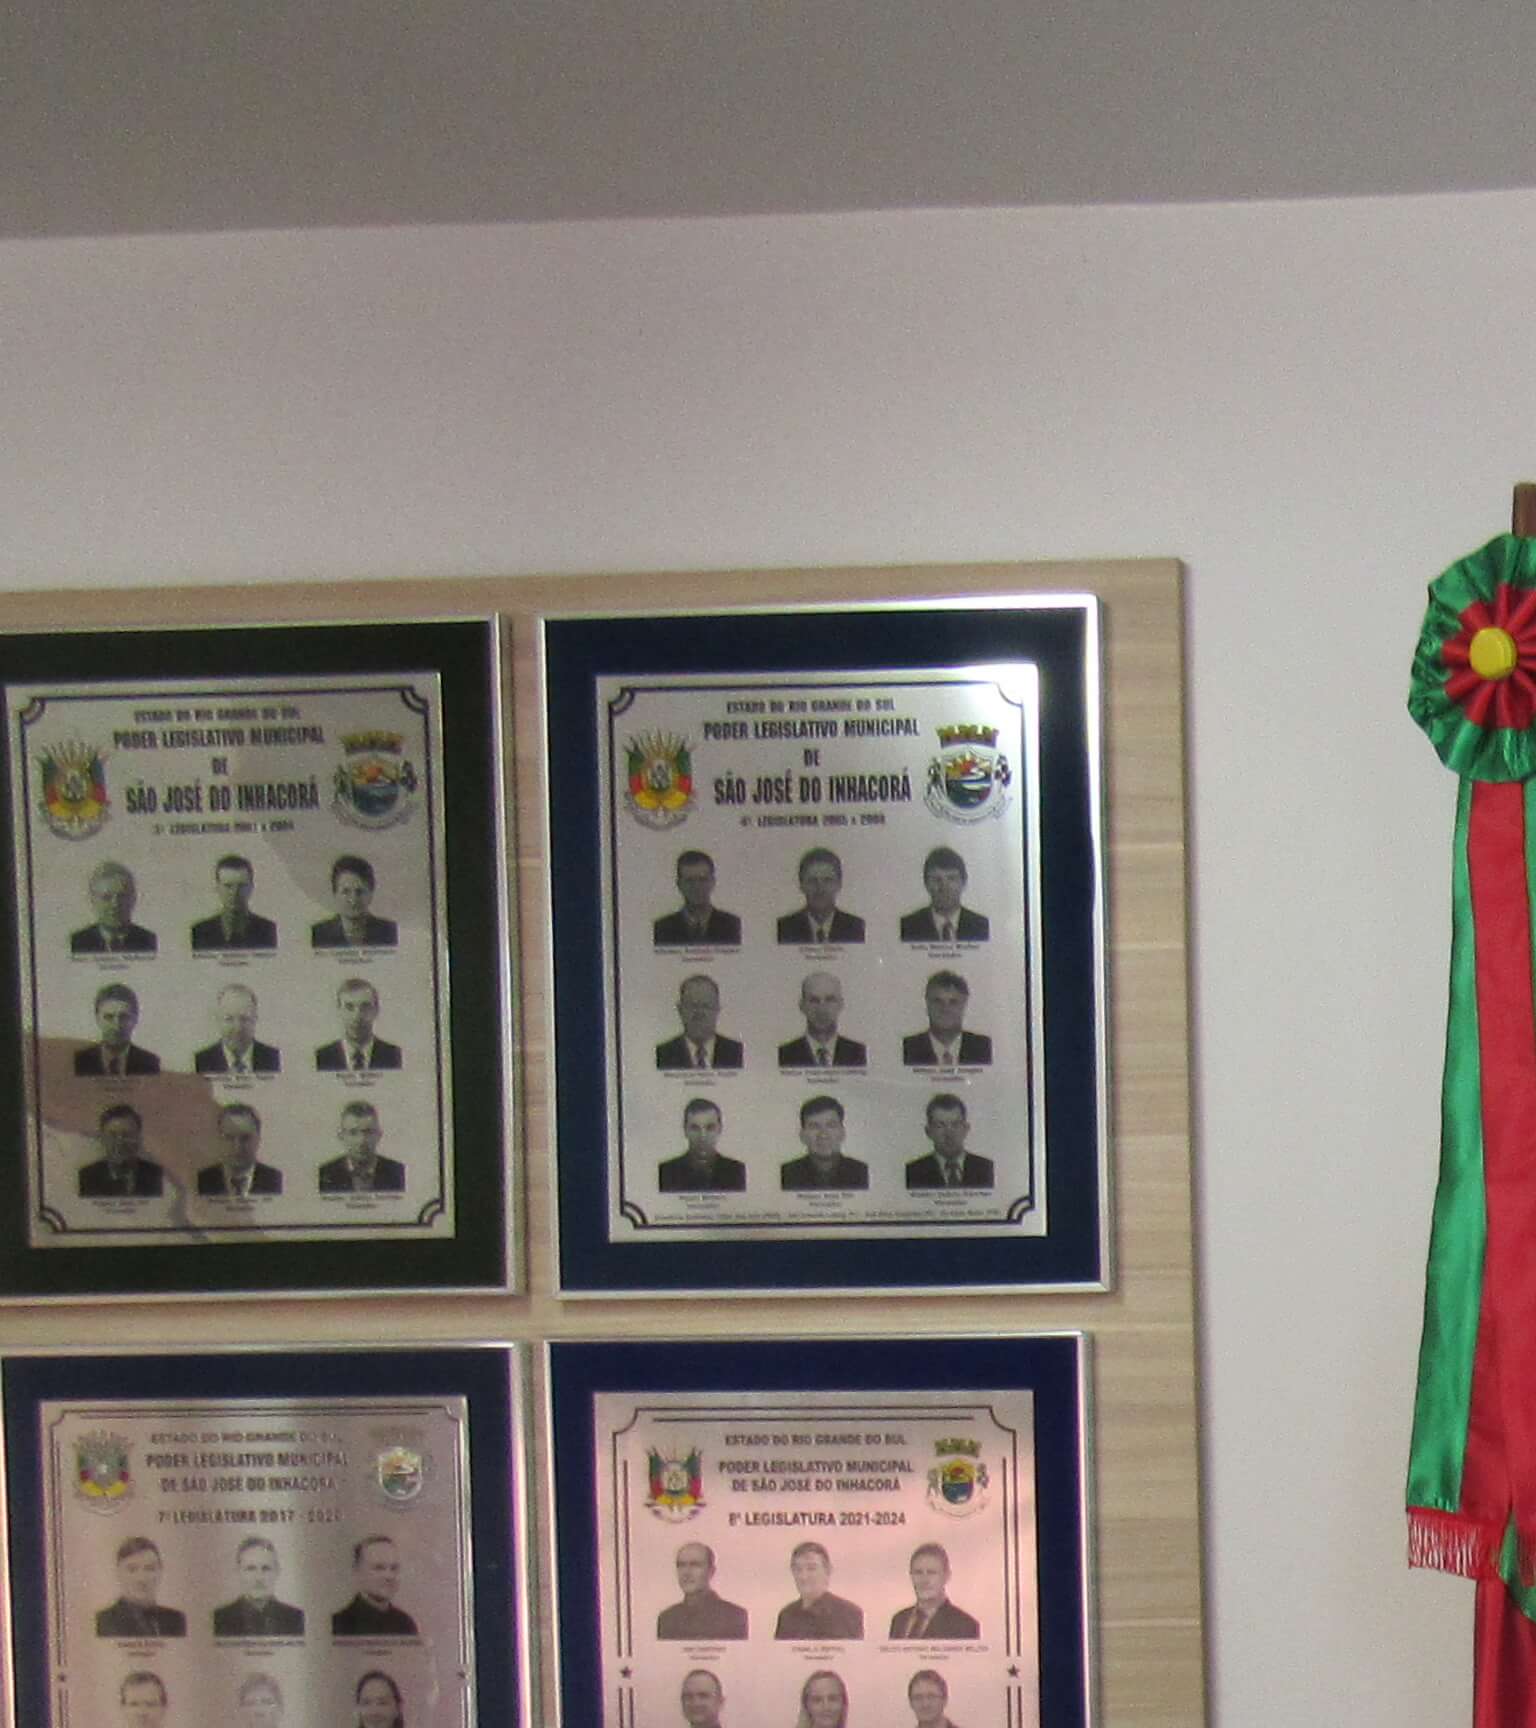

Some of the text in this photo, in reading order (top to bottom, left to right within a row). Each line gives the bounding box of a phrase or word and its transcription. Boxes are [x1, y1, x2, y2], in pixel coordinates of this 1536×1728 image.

[113, 726, 324, 749] PODER LEGISLATIVO MUNICIPAL
[704, 719, 920, 740] PODER LEGISLATIVO MUNICIPAL
[212, 757, 228, 775] DE
[804, 749, 820, 766] DE
[714, 767, 911, 805] SÃO JOSÉ DO INHACORÁ
[725, 1434, 907, 1446] ESTADO DO RIO GRANDE DO SUL
[719, 1460, 914, 1473] PODER LEGISLATIVO MUNICIPAL
[732, 1477, 900, 1492] DE SÃO JOSÉ DO INHACORÁ
[745, 1512, 835, 1525] LEGISLATURA
[840, 1512, 905, 1525] 2021-2024
